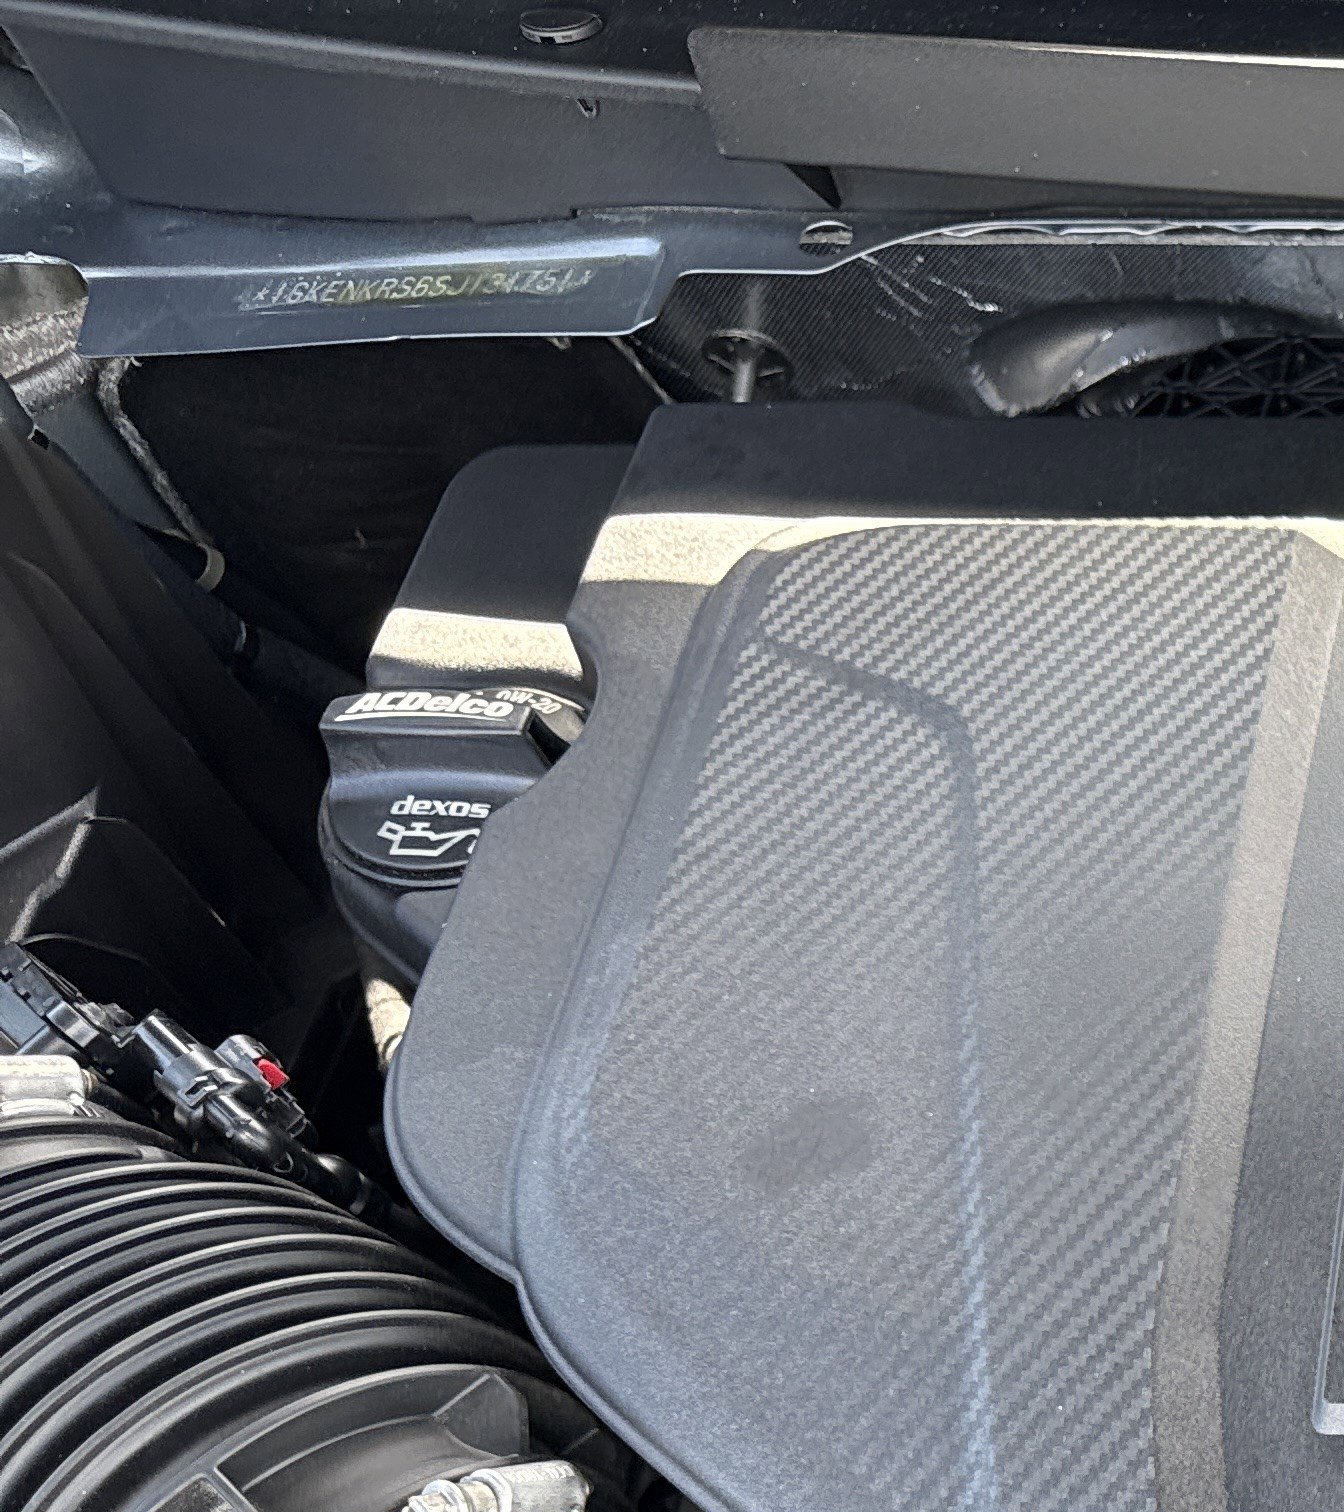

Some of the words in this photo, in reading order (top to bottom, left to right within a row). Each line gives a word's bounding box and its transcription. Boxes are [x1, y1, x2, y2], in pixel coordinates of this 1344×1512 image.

[345, 692, 514, 717] ACDelco
[496, 690, 563, 714] 0W-20
[390, 795, 491, 818] dexos
